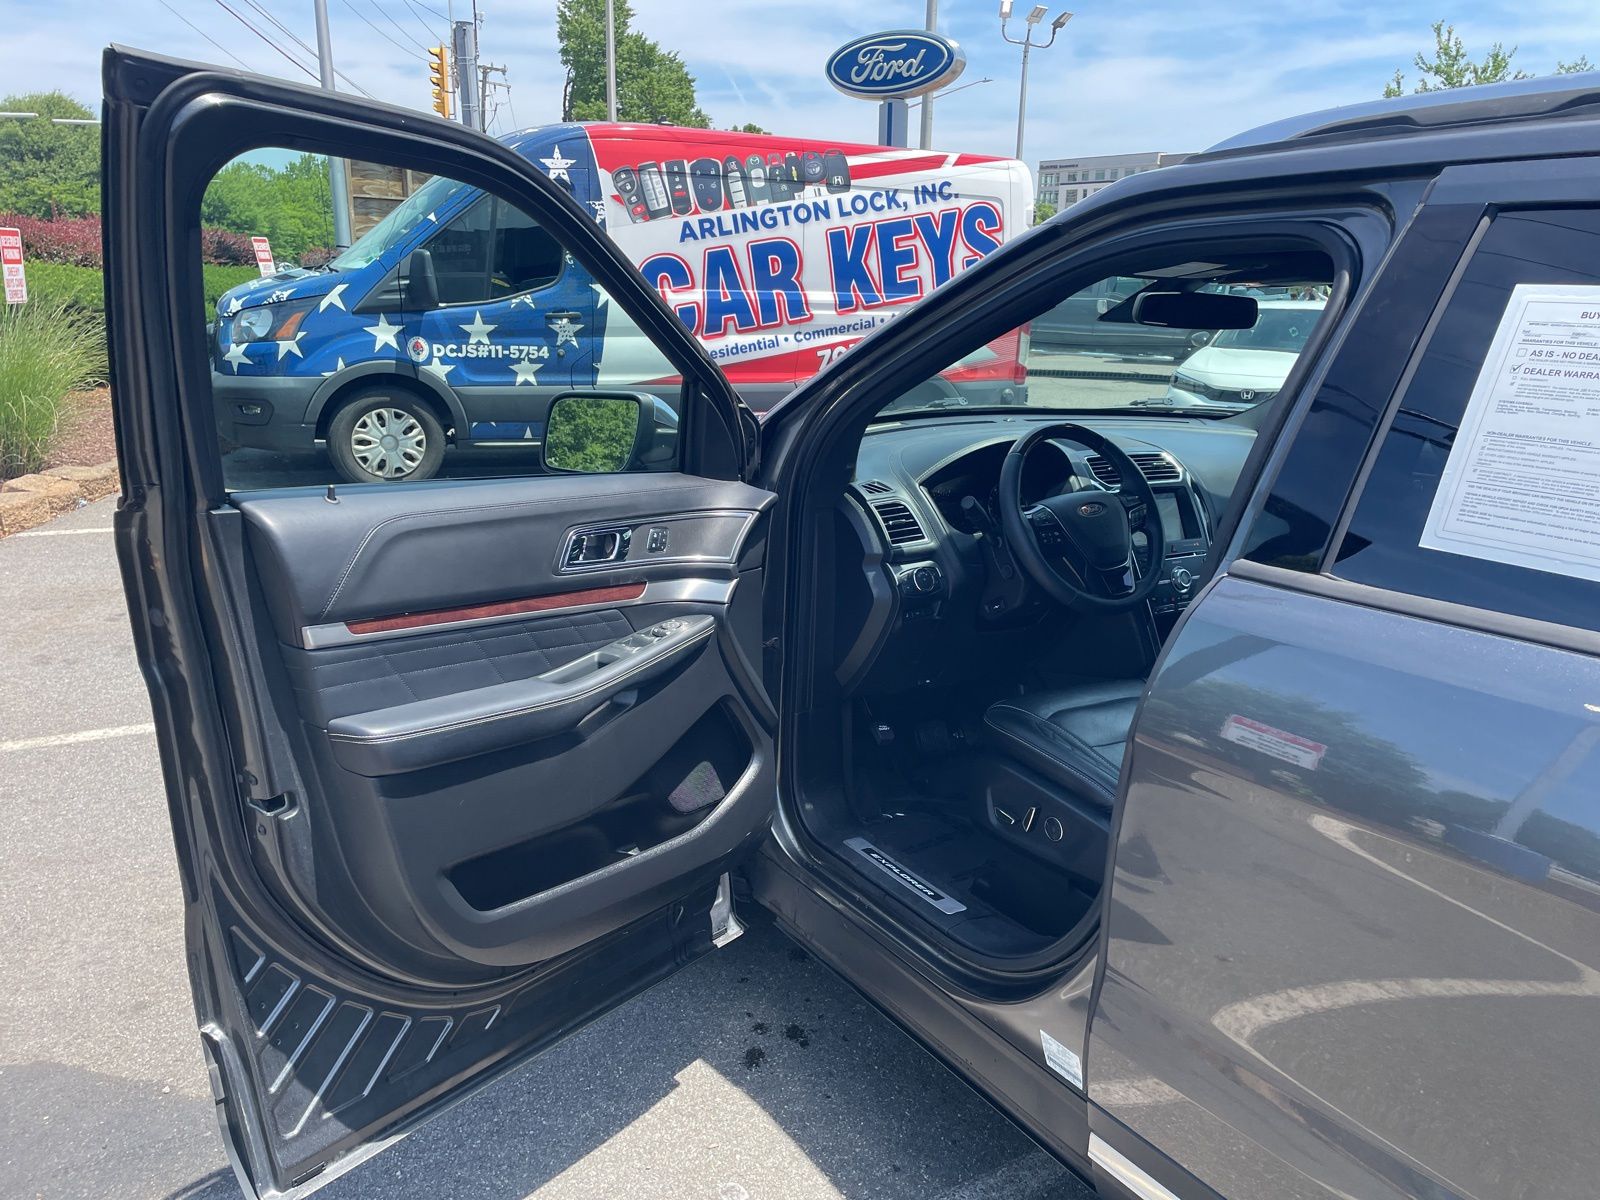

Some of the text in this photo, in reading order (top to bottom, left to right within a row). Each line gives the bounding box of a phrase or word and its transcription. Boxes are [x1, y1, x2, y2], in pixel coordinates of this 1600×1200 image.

[851, 43, 926, 84] Ford
[679, 181, 960, 243] ARLINGTON LOCK, INC.
[639, 201, 1004, 341] CAR KEYS
[432, 343, 550, 360] DCJS#11-5754
[709, 316, 876, 360] esidential Commercial
[1530, 350, 1543, 358] AS
[1545, 350, 1555, 358] IS
[1562, 351, 1577, 359] NO
[1578, 352, 1600, 361] DEA
[1523, 367, 1561, 377] DEALER
[869, 852, 936, 897] EXPLORER
